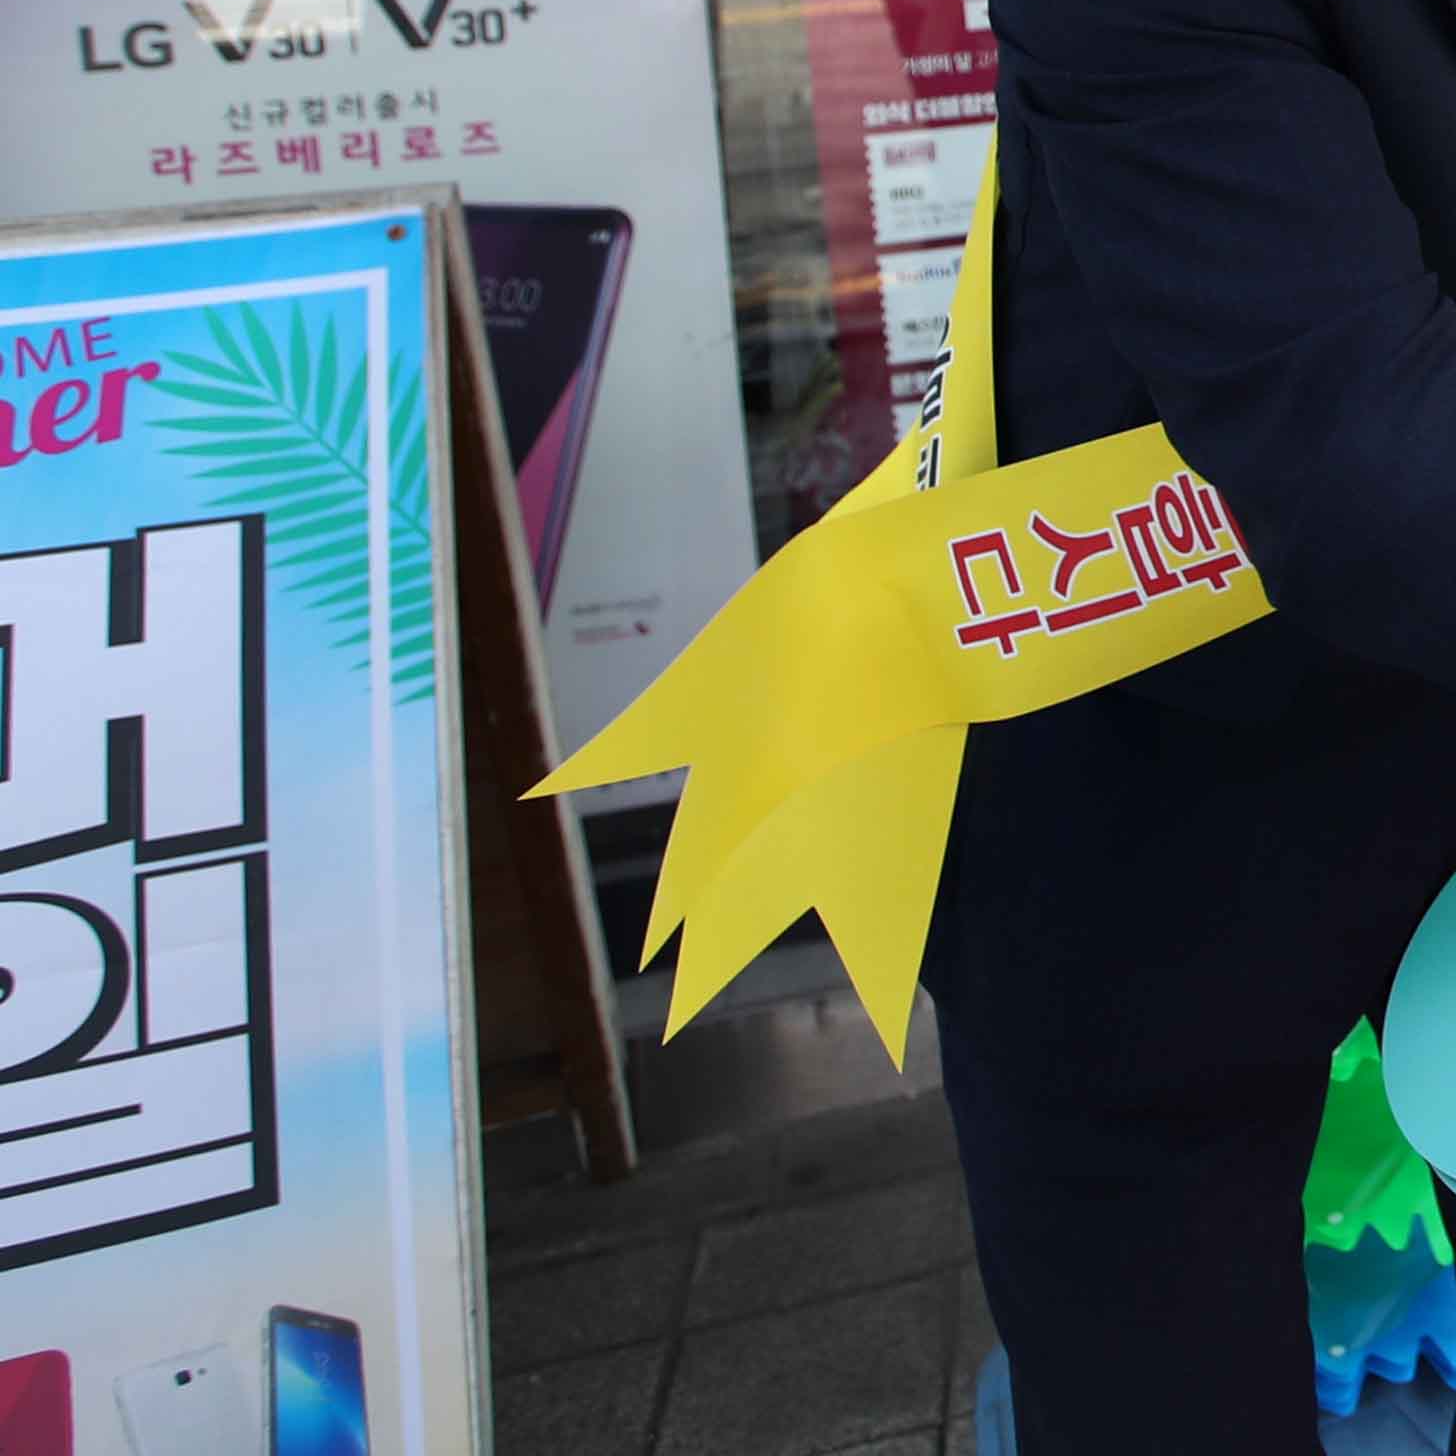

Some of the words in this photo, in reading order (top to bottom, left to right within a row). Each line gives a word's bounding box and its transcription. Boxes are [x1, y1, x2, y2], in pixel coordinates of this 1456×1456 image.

[78, 19, 174, 73] LG
[149, 120, 503, 187] 라즈베리로즈
[0, 315, 118, 379] ME
